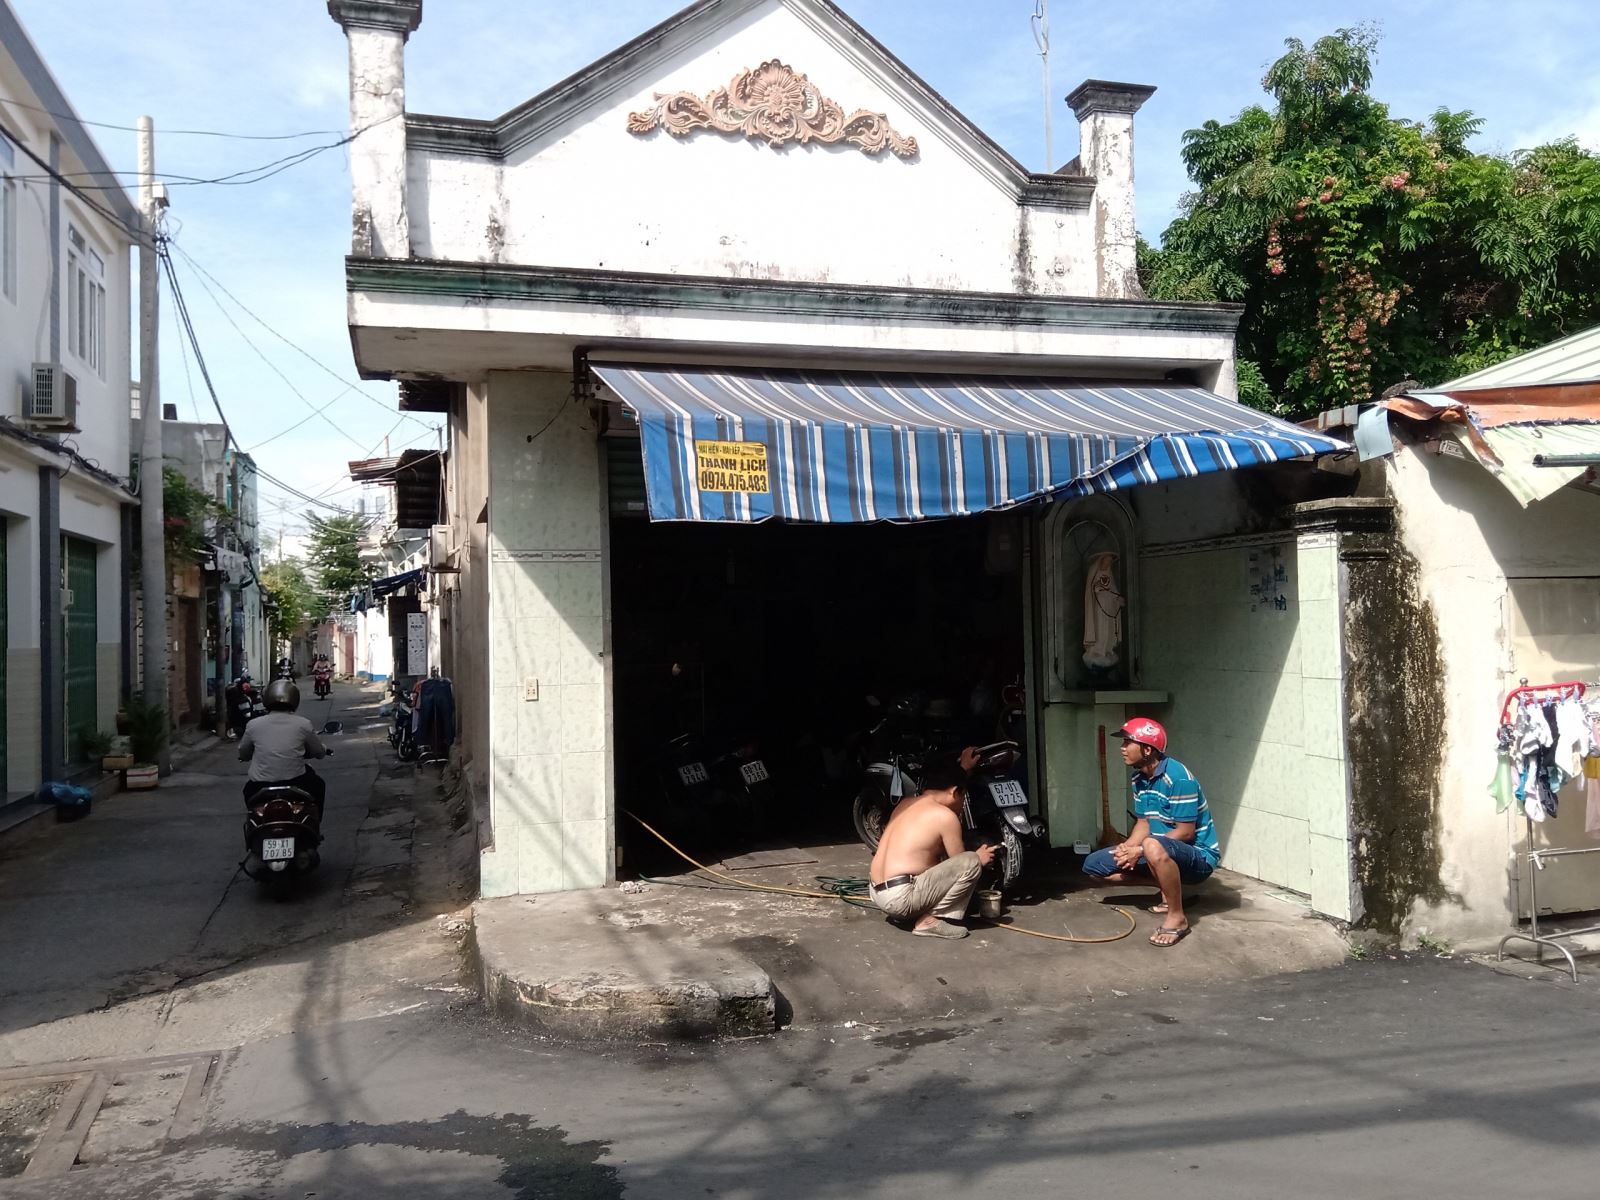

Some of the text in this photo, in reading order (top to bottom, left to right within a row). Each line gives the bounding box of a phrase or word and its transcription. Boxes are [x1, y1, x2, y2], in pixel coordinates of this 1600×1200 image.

[699, 456, 767, 474] THANH LỊCH
[701, 471, 768, 492] 0974.475.483
[998, 792, 1023, 805] 8725
